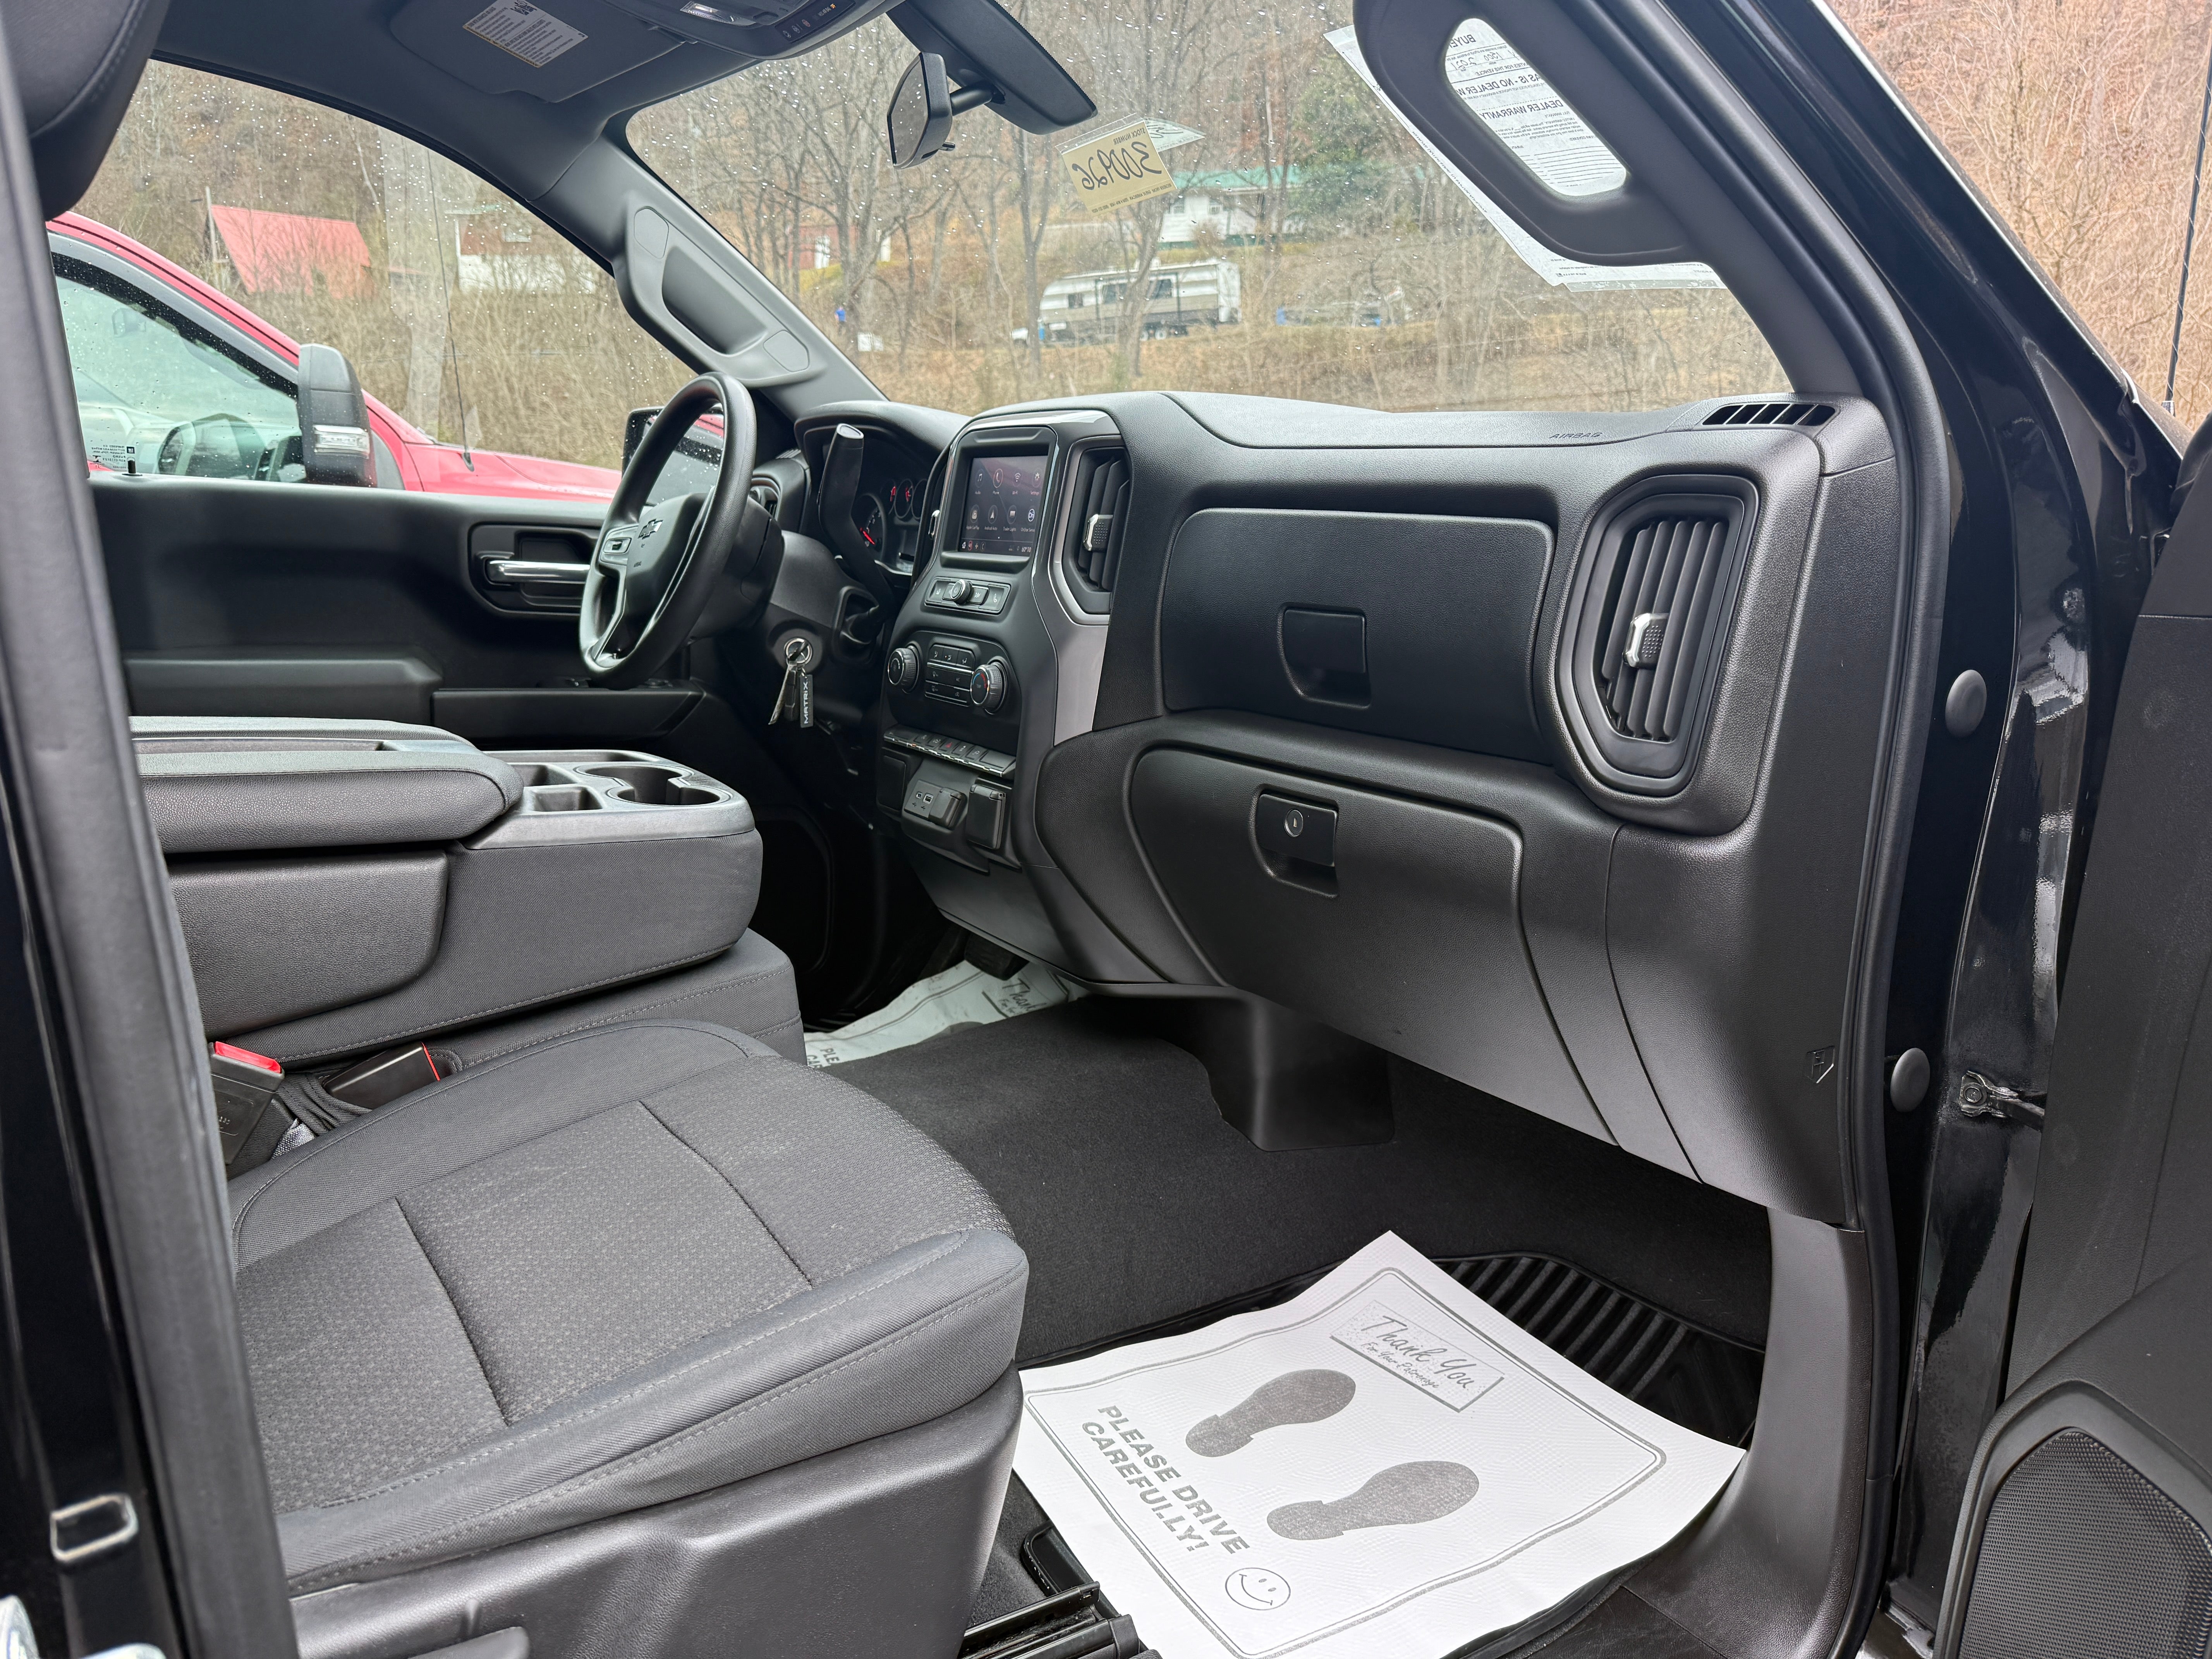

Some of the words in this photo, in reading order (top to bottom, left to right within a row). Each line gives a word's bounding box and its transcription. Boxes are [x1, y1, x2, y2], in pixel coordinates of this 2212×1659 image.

[819, 1048, 840, 1064] PLE
[1361, 1315, 1448, 1362] Thank
[1434, 1359, 1477, 1389] You
[1361, 1342, 1378, 1352] For
[1377, 1351, 1398, 1364] Your
[1396, 1362, 1439, 1388] Patronage
[1082, 1422, 1209, 1552] CAREFULLY!
[1097, 1405, 1182, 1482] PLEASE
[1171, 1485, 1250, 1554] DRIVE
